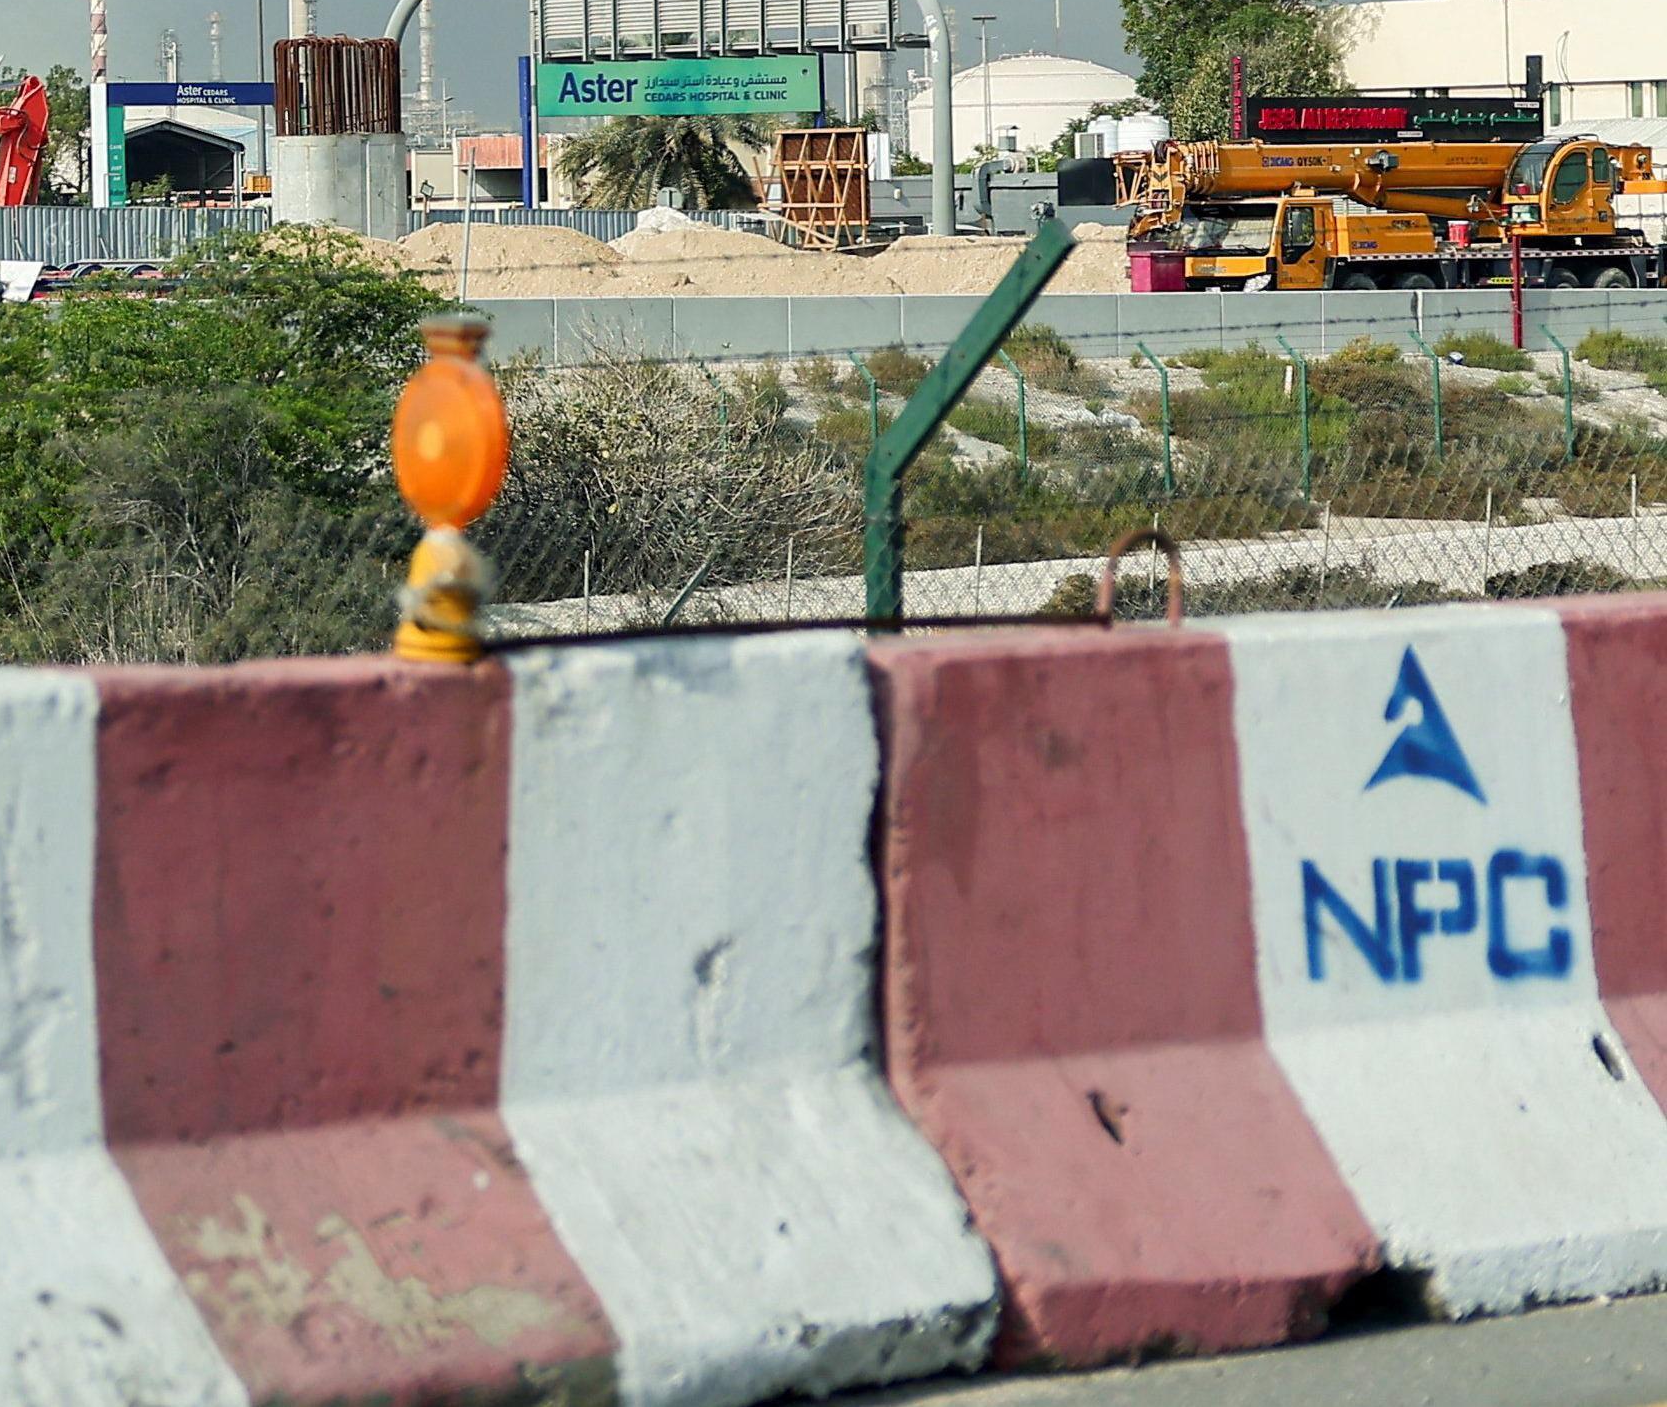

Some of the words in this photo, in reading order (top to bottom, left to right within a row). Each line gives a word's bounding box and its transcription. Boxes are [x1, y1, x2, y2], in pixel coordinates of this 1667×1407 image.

[558, 71, 638, 103] Aster
[741, 72, 788, 88] مستشفى
[177, 84, 202, 96] Aster
[644, 92, 687, 102] CEDARS
[690, 91, 740, 102] HOSPITAL
[743, 91, 750, 100] &
[754, 90, 788, 100] CLINIC
[1300, 846, 1575, 986] NPC
